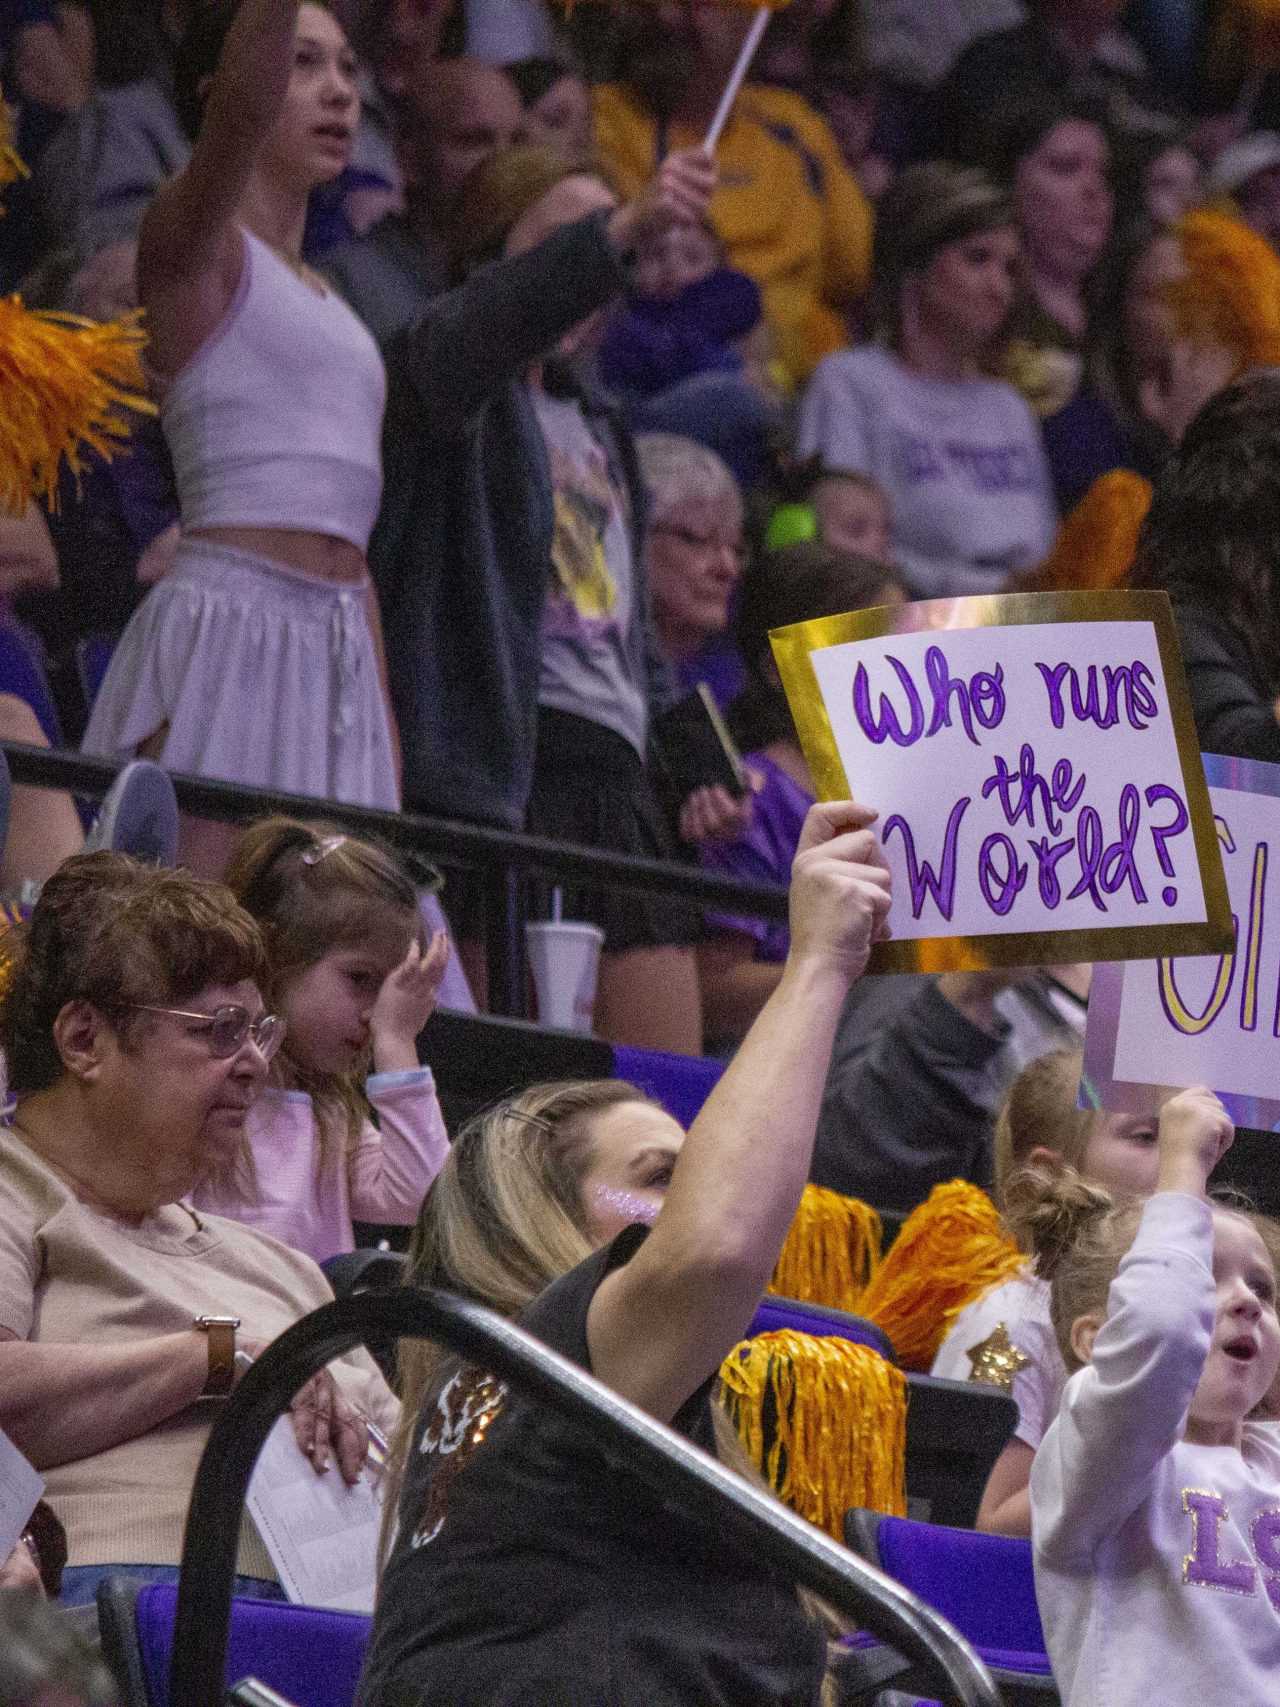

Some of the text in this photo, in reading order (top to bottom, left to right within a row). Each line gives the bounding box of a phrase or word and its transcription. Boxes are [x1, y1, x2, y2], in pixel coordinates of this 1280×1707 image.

[852, 645, 1158, 747] Who runs
[981, 743, 1087, 836] the
[881, 782, 1190, 923] World?
